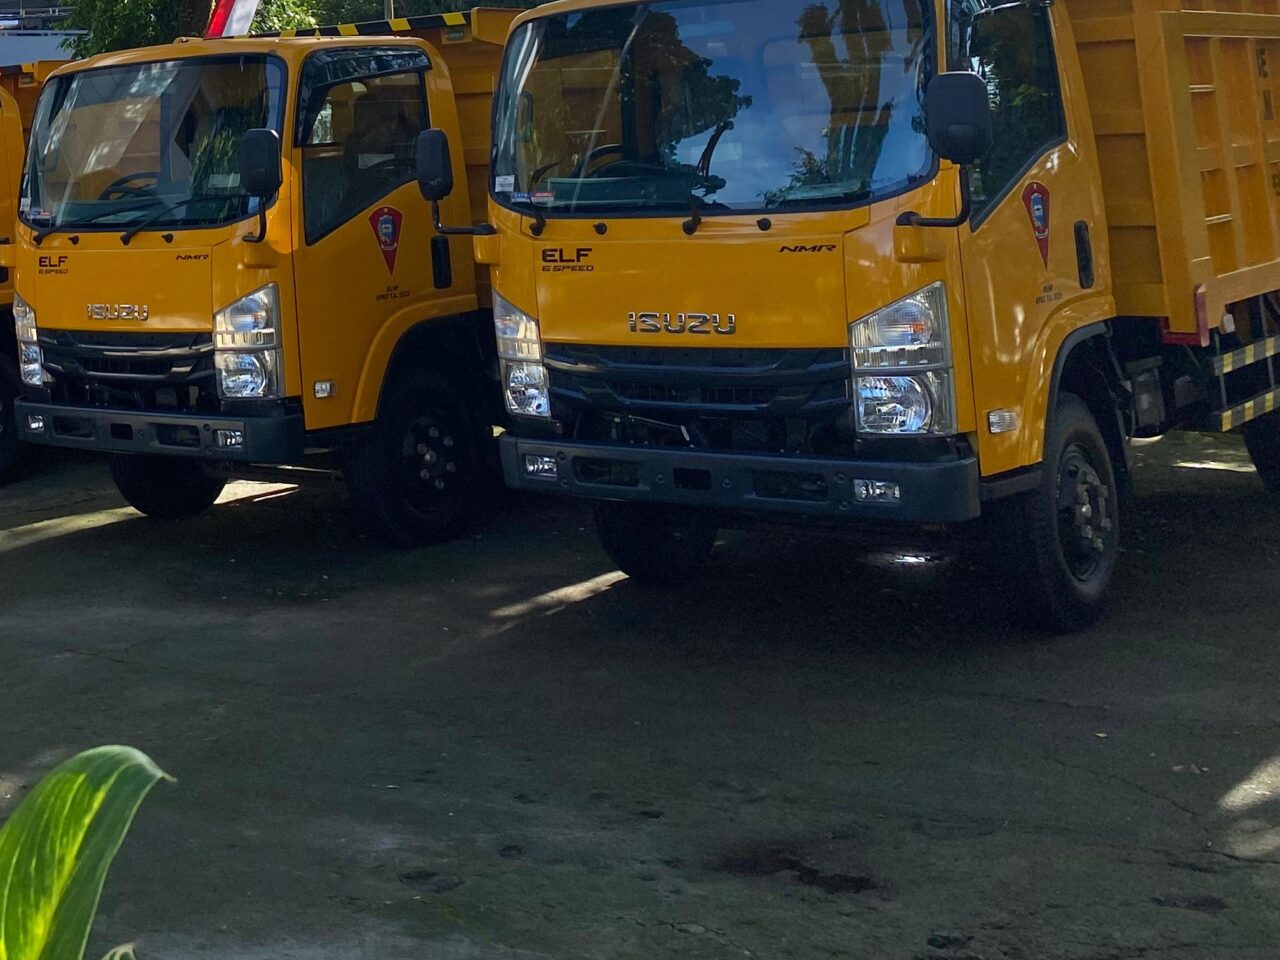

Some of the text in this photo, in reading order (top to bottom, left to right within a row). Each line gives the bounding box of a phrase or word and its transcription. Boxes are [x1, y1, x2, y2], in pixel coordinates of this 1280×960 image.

[542, 247, 592, 263] ELF
[779, 244, 837, 253] NMR
[38, 256, 68, 268] ELF
[87, 304, 149, 321] ISUZU
[628, 311, 736, 334] ISUZU
